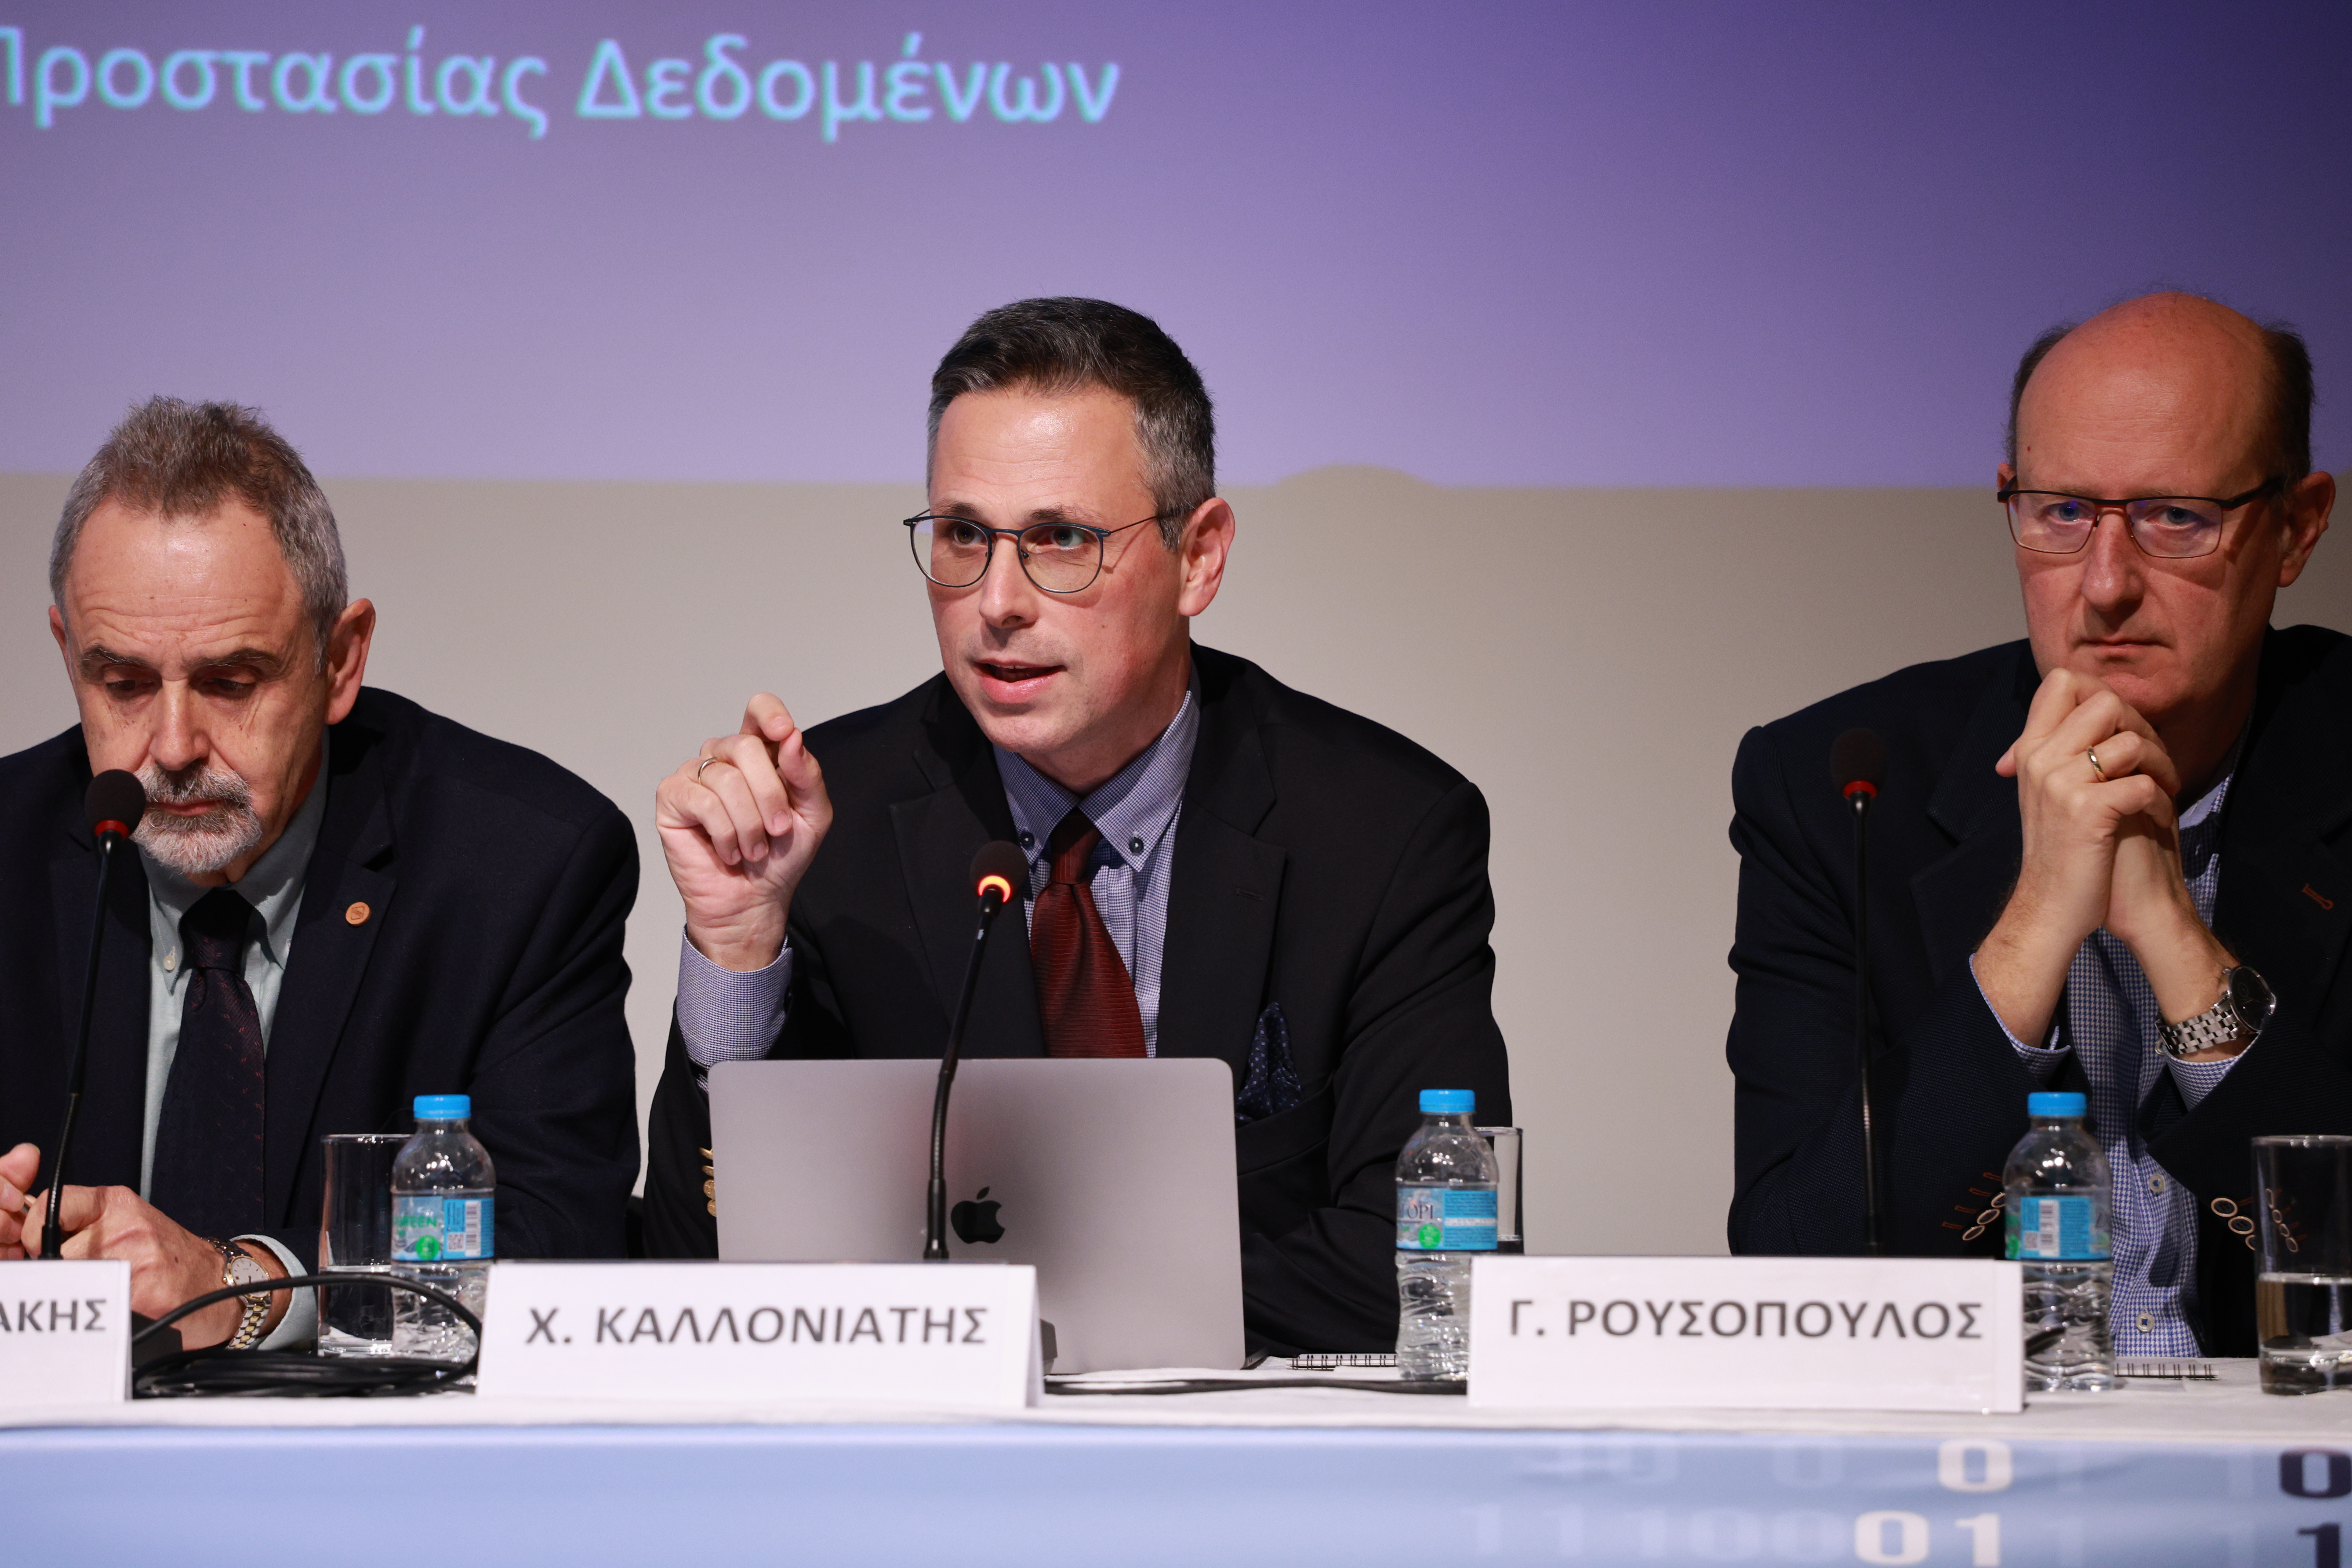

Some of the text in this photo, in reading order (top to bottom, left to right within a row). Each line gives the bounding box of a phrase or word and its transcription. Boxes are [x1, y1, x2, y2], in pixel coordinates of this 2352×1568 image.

[576, 32, 1119, 143] Δεδομένων
[526, 1306, 987, 1344] Χ. ΚΑΛΛΟΝΙΑΤΗΣ
[1510, 1299, 1982, 1339] Γ. ΡΟΥΣΟΠΟΥΛΟΣ
